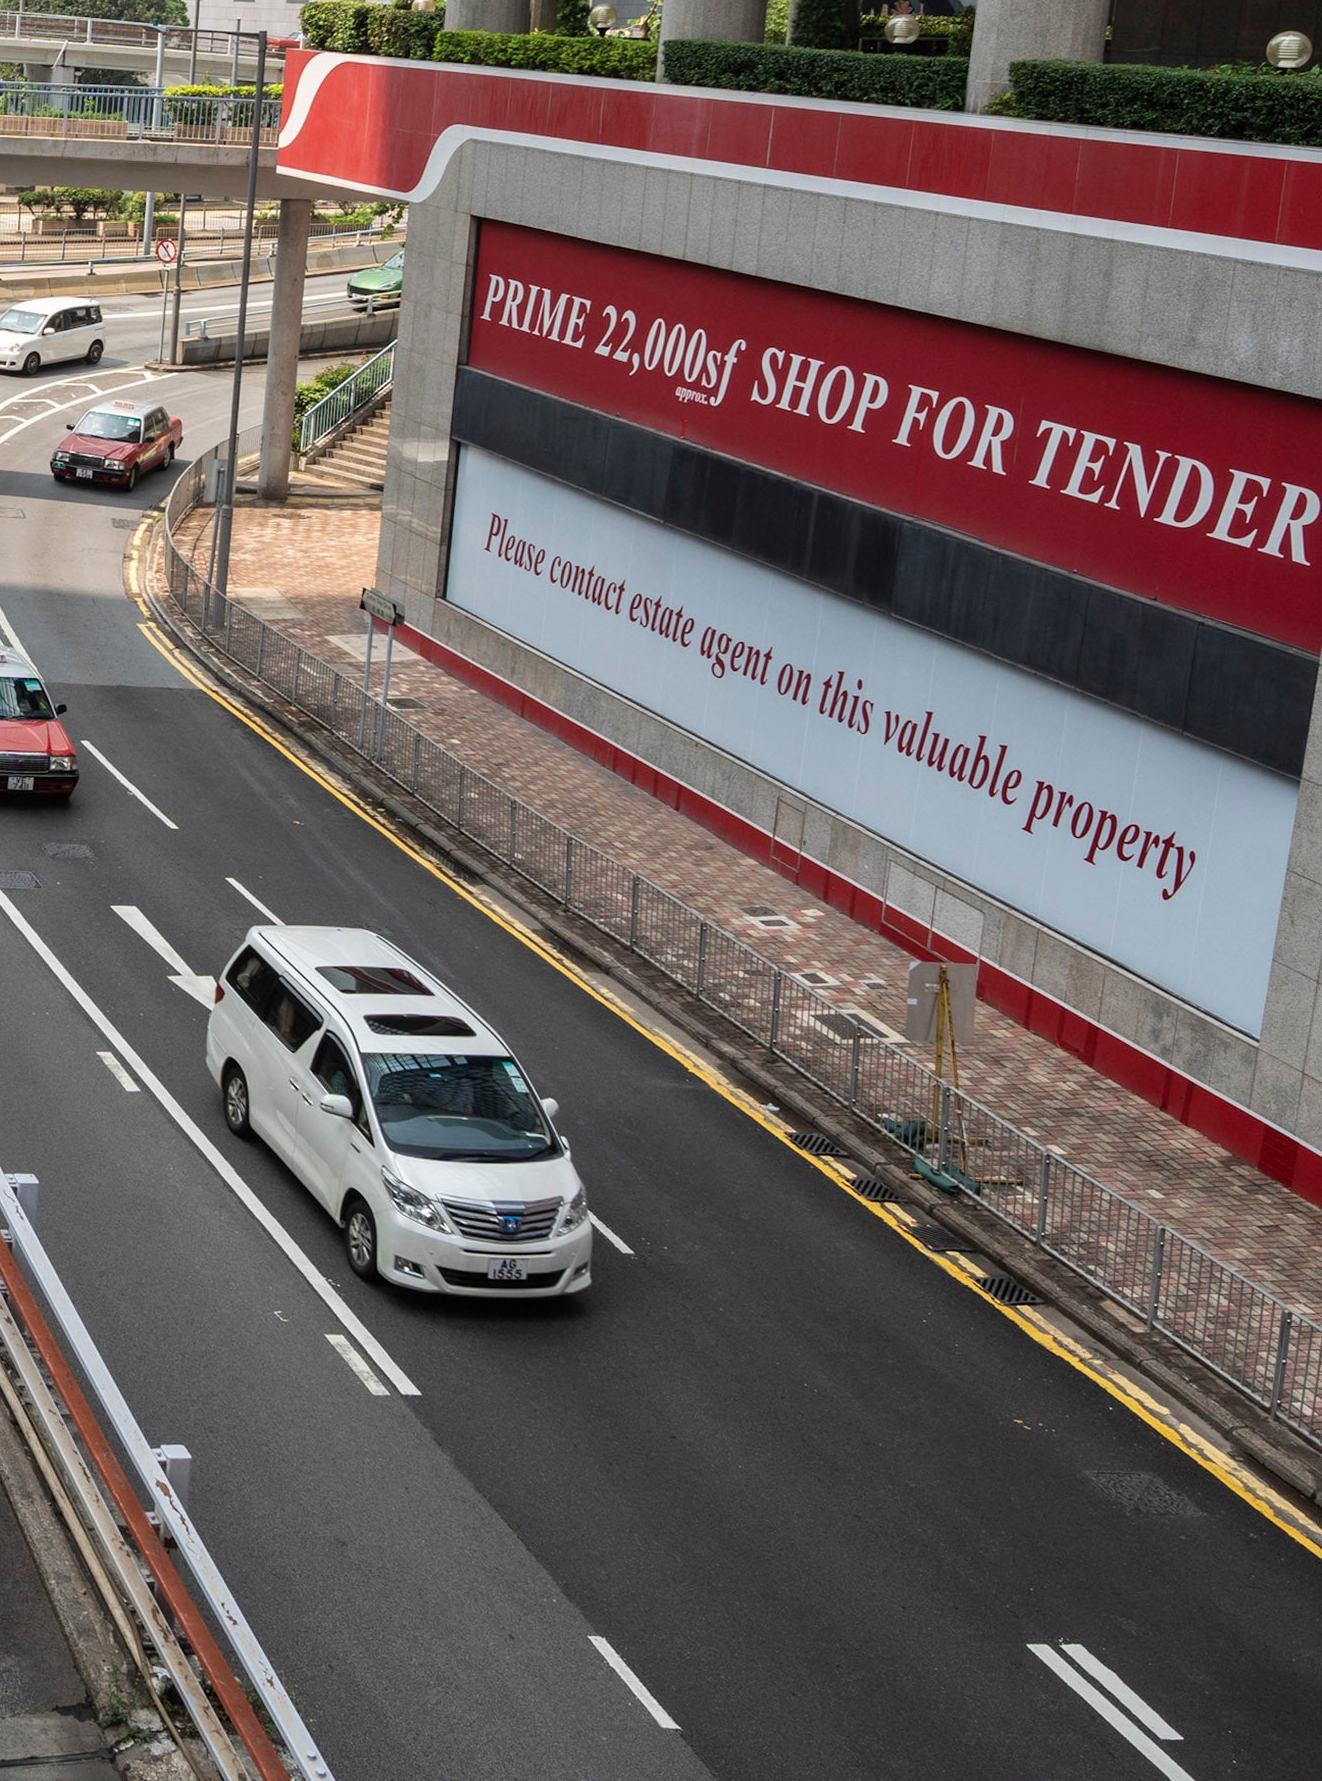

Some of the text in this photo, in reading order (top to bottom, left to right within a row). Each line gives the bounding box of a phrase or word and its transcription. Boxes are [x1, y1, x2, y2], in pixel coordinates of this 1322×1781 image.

[674, 384, 709, 405] approx.
[480, 274, 1321, 566] PRIME 22,000sf SHOP FOR TENDER
[484, 512, 1196, 901] Please contact estate agent on this valuable property
[493, 1268, 522, 1279] 1555
[502, 1259, 517, 1269] AG
